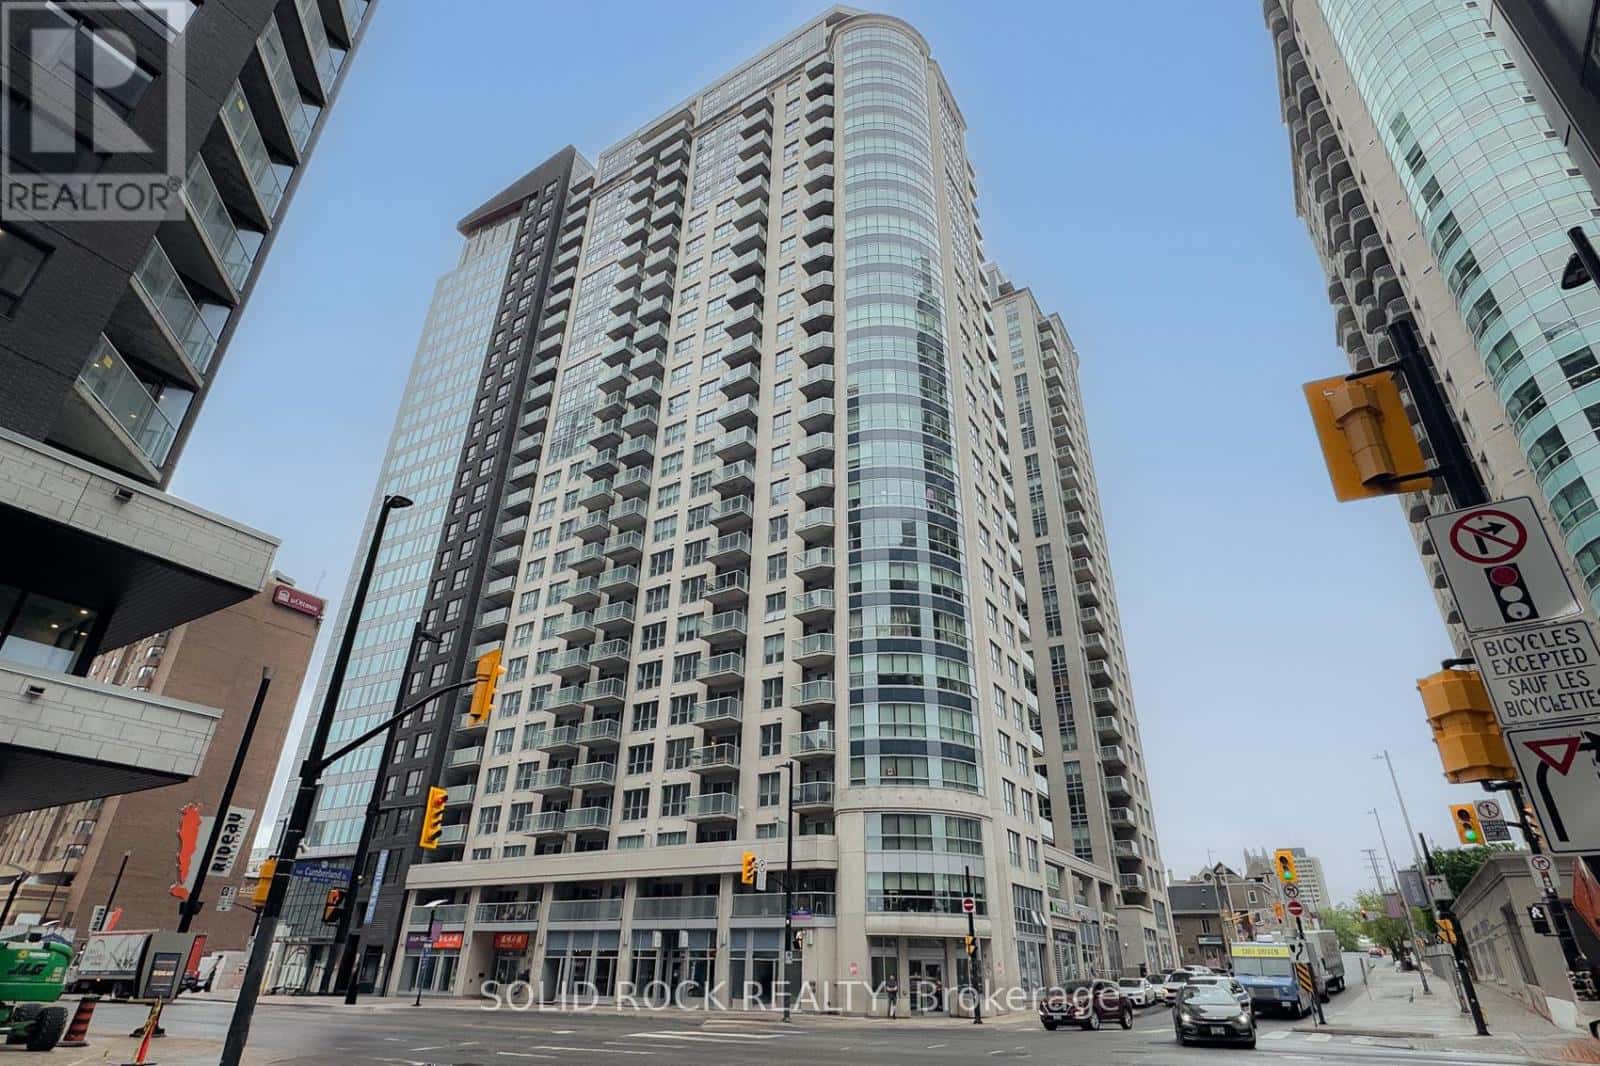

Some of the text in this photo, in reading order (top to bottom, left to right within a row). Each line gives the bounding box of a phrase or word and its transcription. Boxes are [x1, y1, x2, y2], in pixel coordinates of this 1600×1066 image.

[1483, 627, 1581, 657] BICYCLES
[1492, 647, 1588, 676] EXCEPTED
[1507, 670, 1591, 697] SAUF LES
[8, 962, 47, 976] JLG
